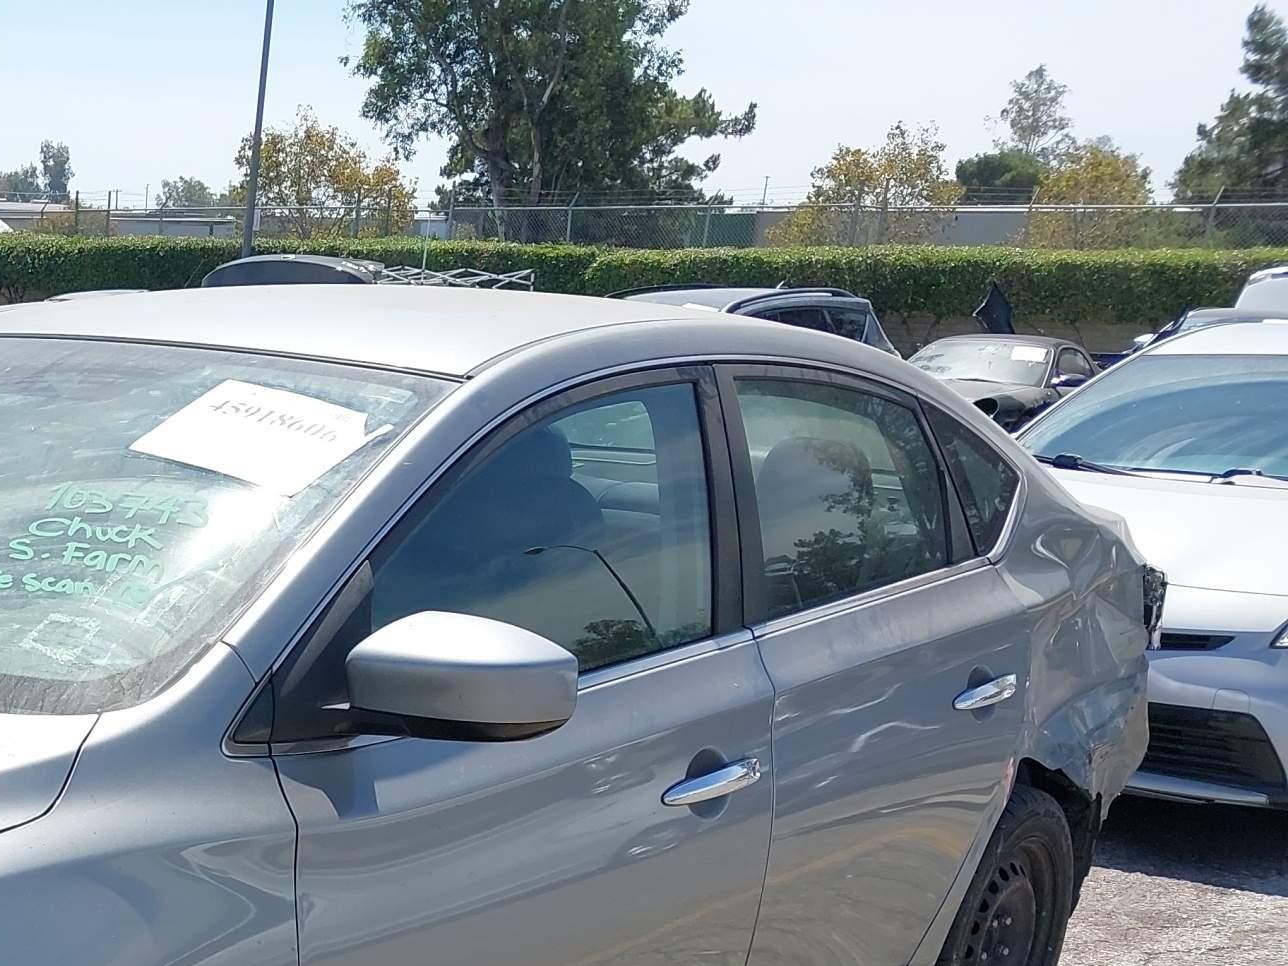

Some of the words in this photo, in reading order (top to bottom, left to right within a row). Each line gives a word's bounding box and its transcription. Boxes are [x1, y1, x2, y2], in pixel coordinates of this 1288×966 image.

[208, 399, 337, 442] 45918606
[28, 515, 165, 550] Chuck
[62, 541, 165, 582] Farm
